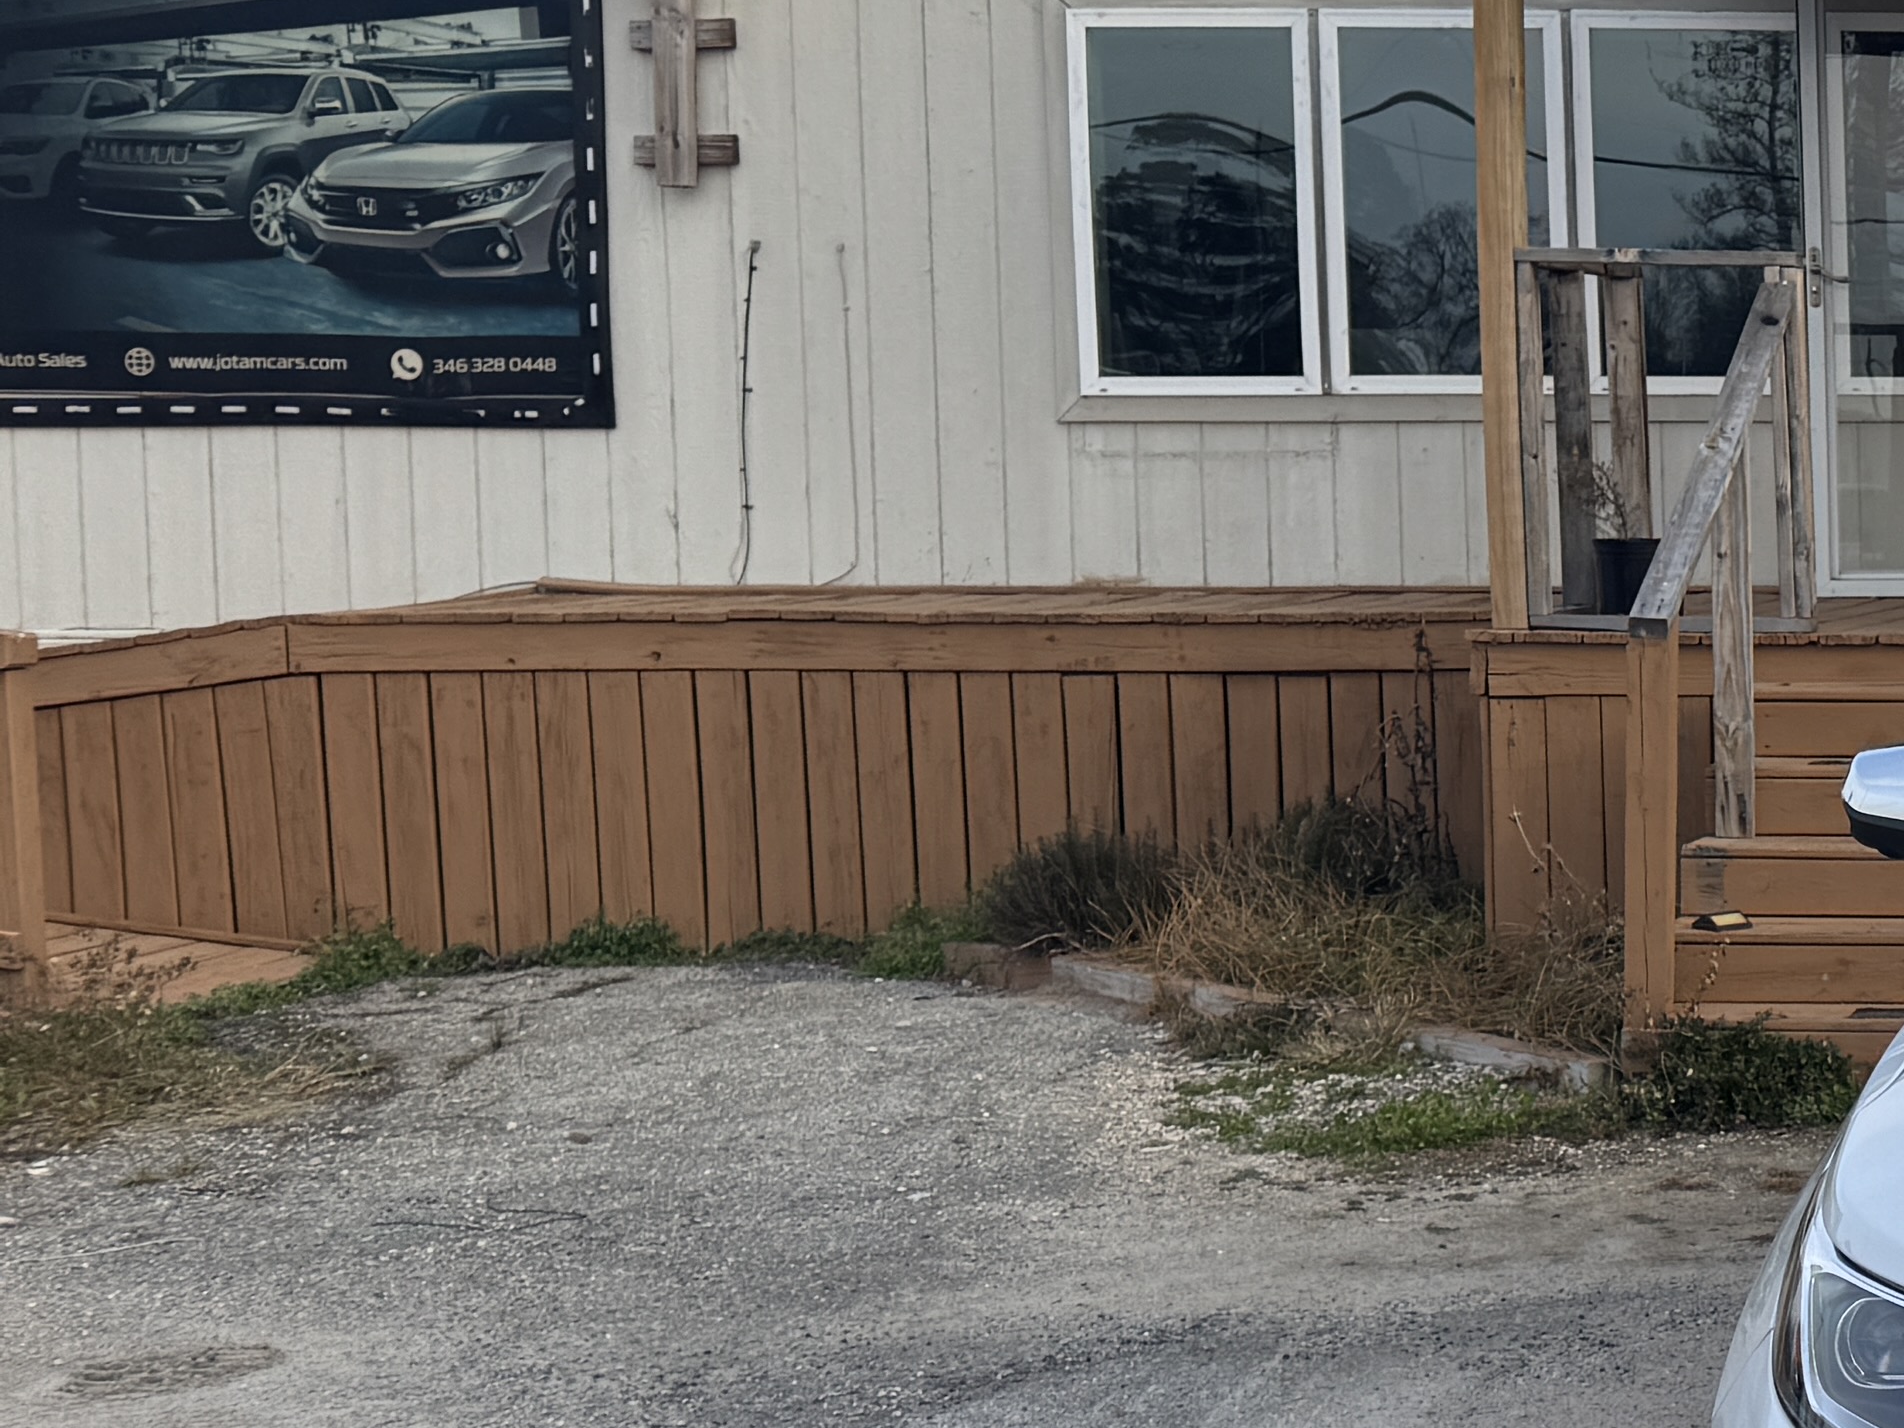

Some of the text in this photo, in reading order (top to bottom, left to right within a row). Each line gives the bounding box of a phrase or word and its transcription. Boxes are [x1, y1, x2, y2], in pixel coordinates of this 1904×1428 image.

[38, 352, 87, 368] Sales
[169, 355, 347, 371] www.jotamcars.com
[433, 357, 557, 374] 346 328 0448
